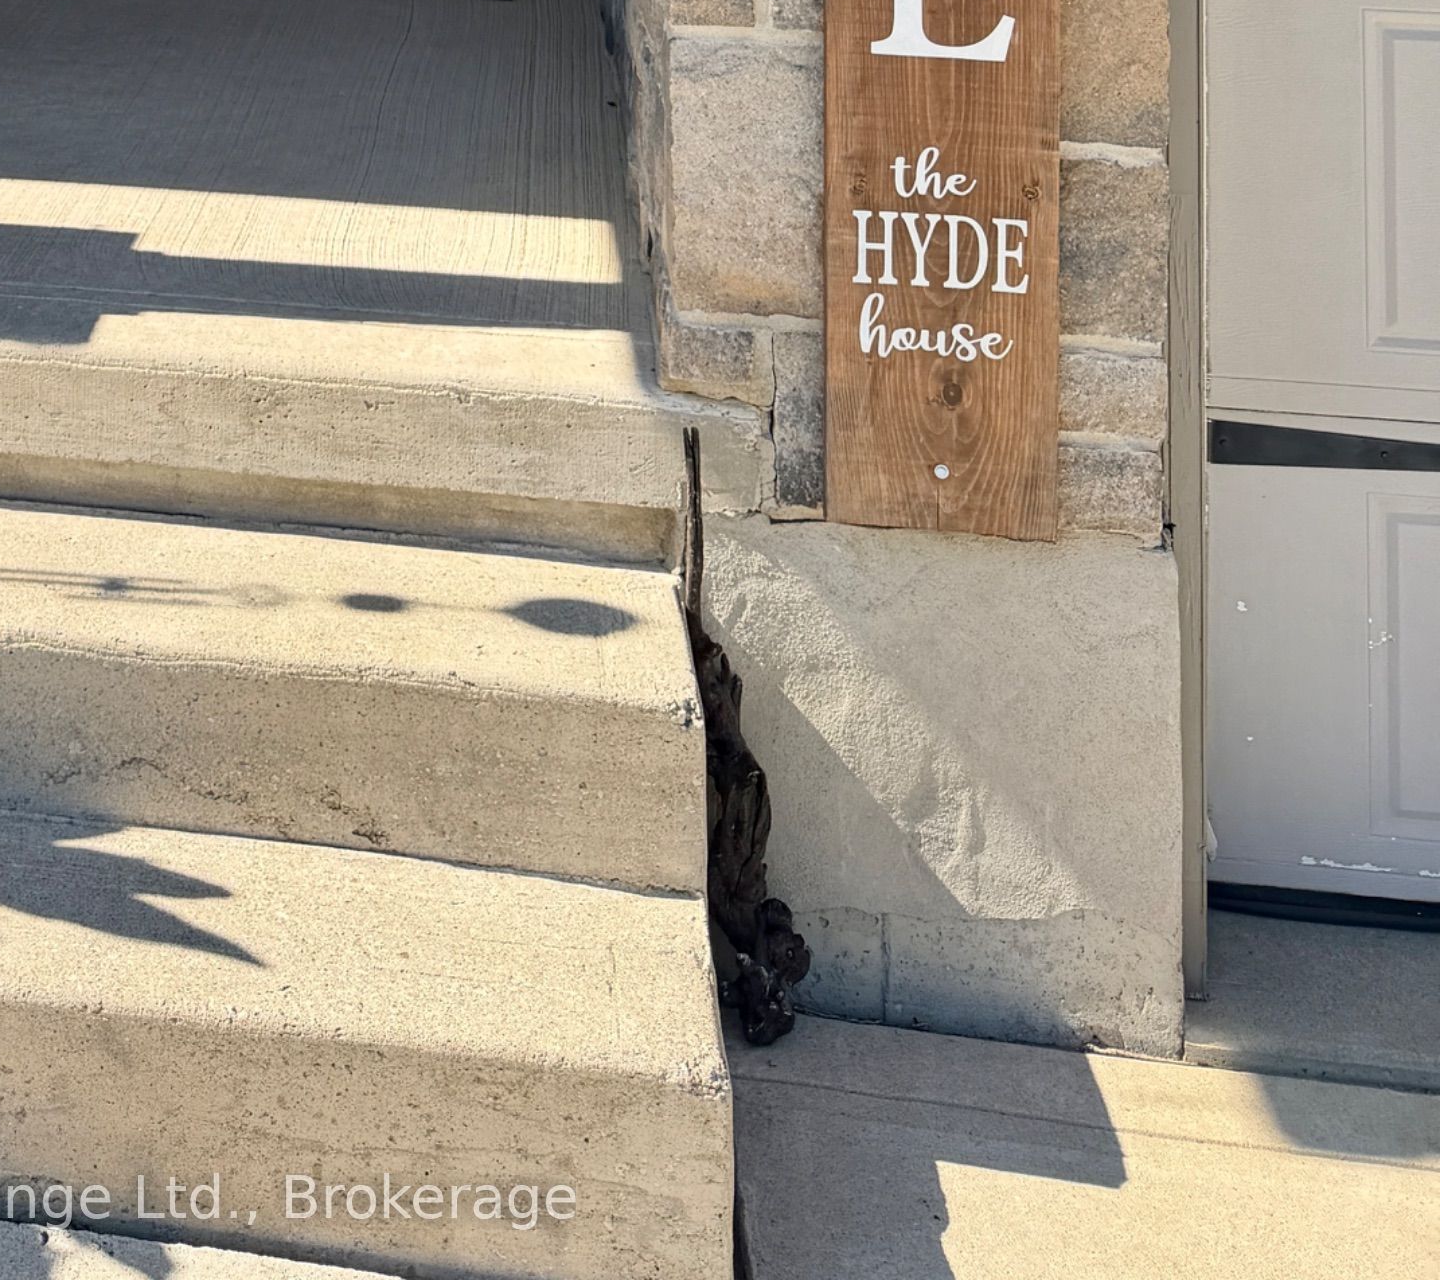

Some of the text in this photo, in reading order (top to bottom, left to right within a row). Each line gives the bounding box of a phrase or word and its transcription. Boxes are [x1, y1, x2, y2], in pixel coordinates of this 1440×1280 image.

[889, 146, 978, 199] the
[852, 209, 1030, 295] HYDE
[858, 292, 1014, 363] house
